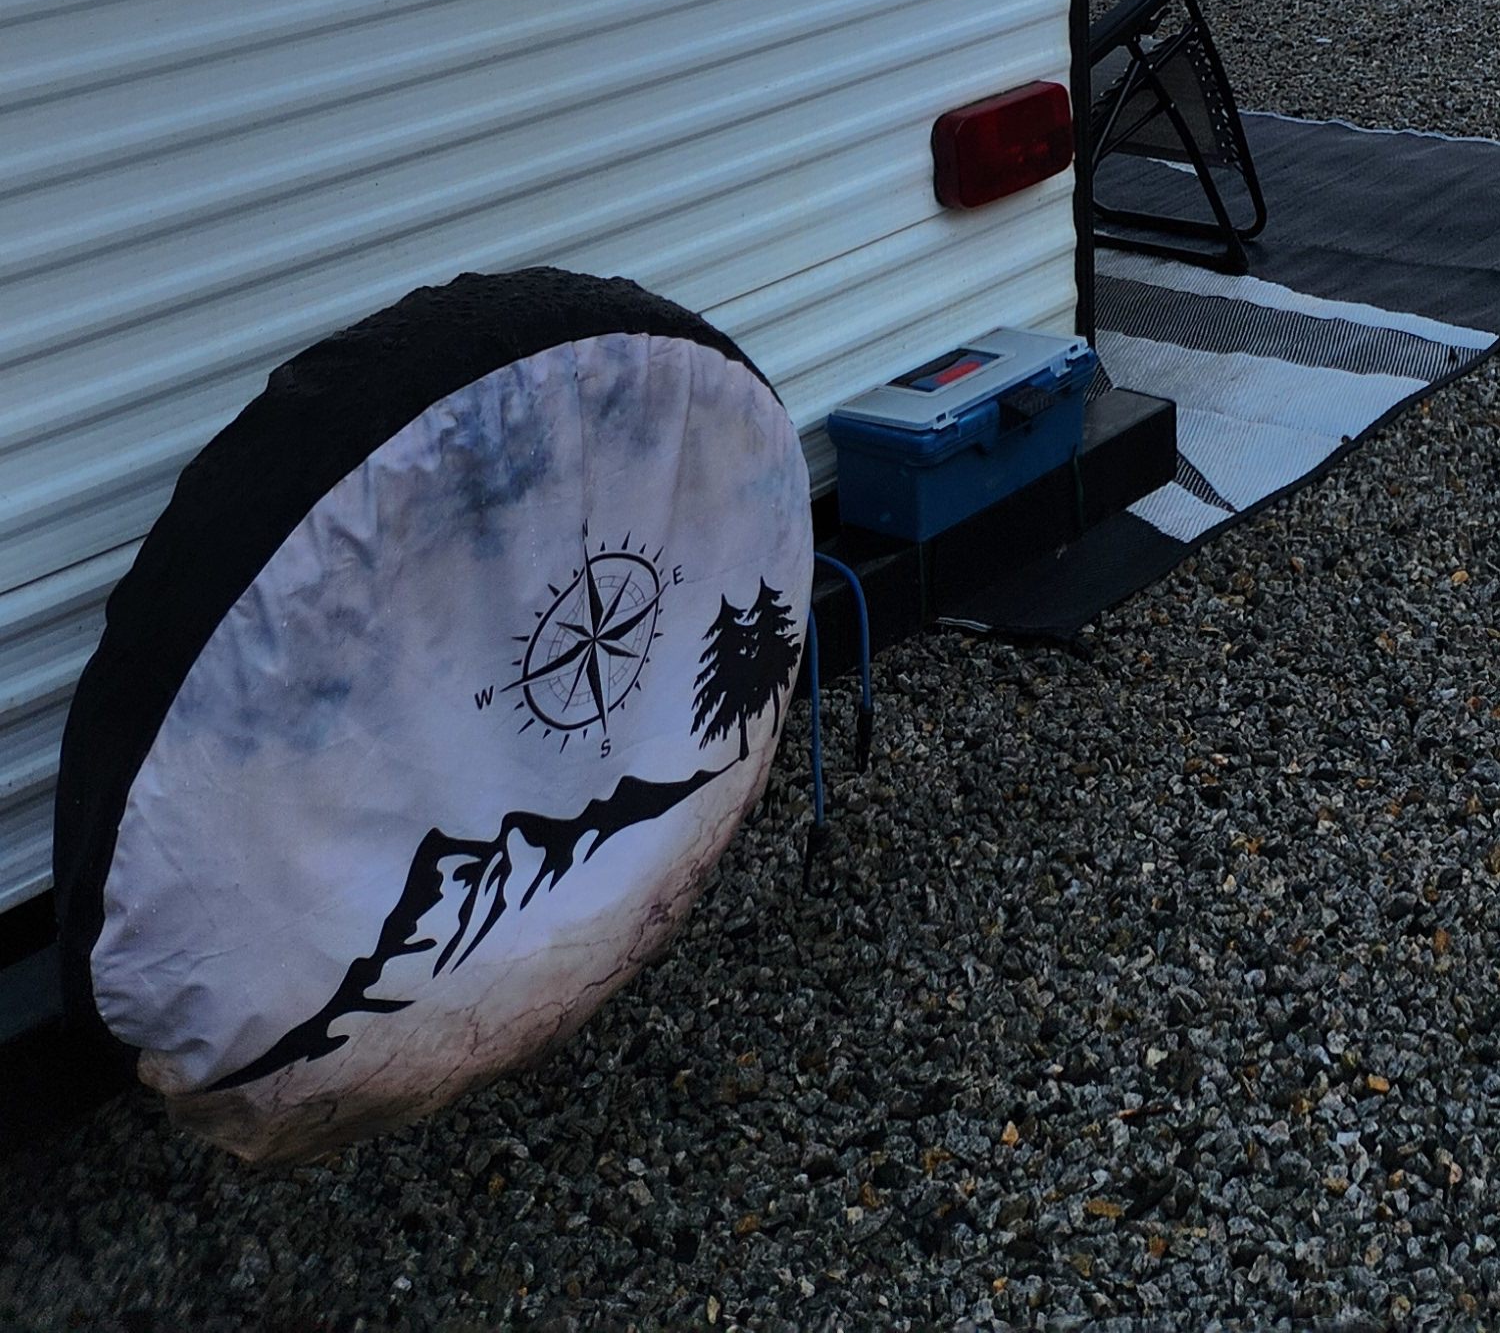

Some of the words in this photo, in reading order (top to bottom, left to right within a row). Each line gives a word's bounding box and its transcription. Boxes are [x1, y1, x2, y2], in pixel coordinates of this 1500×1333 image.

[672, 565, 684, 585] E
[475, 686, 494, 710] W
[600, 739, 611, 758] S
